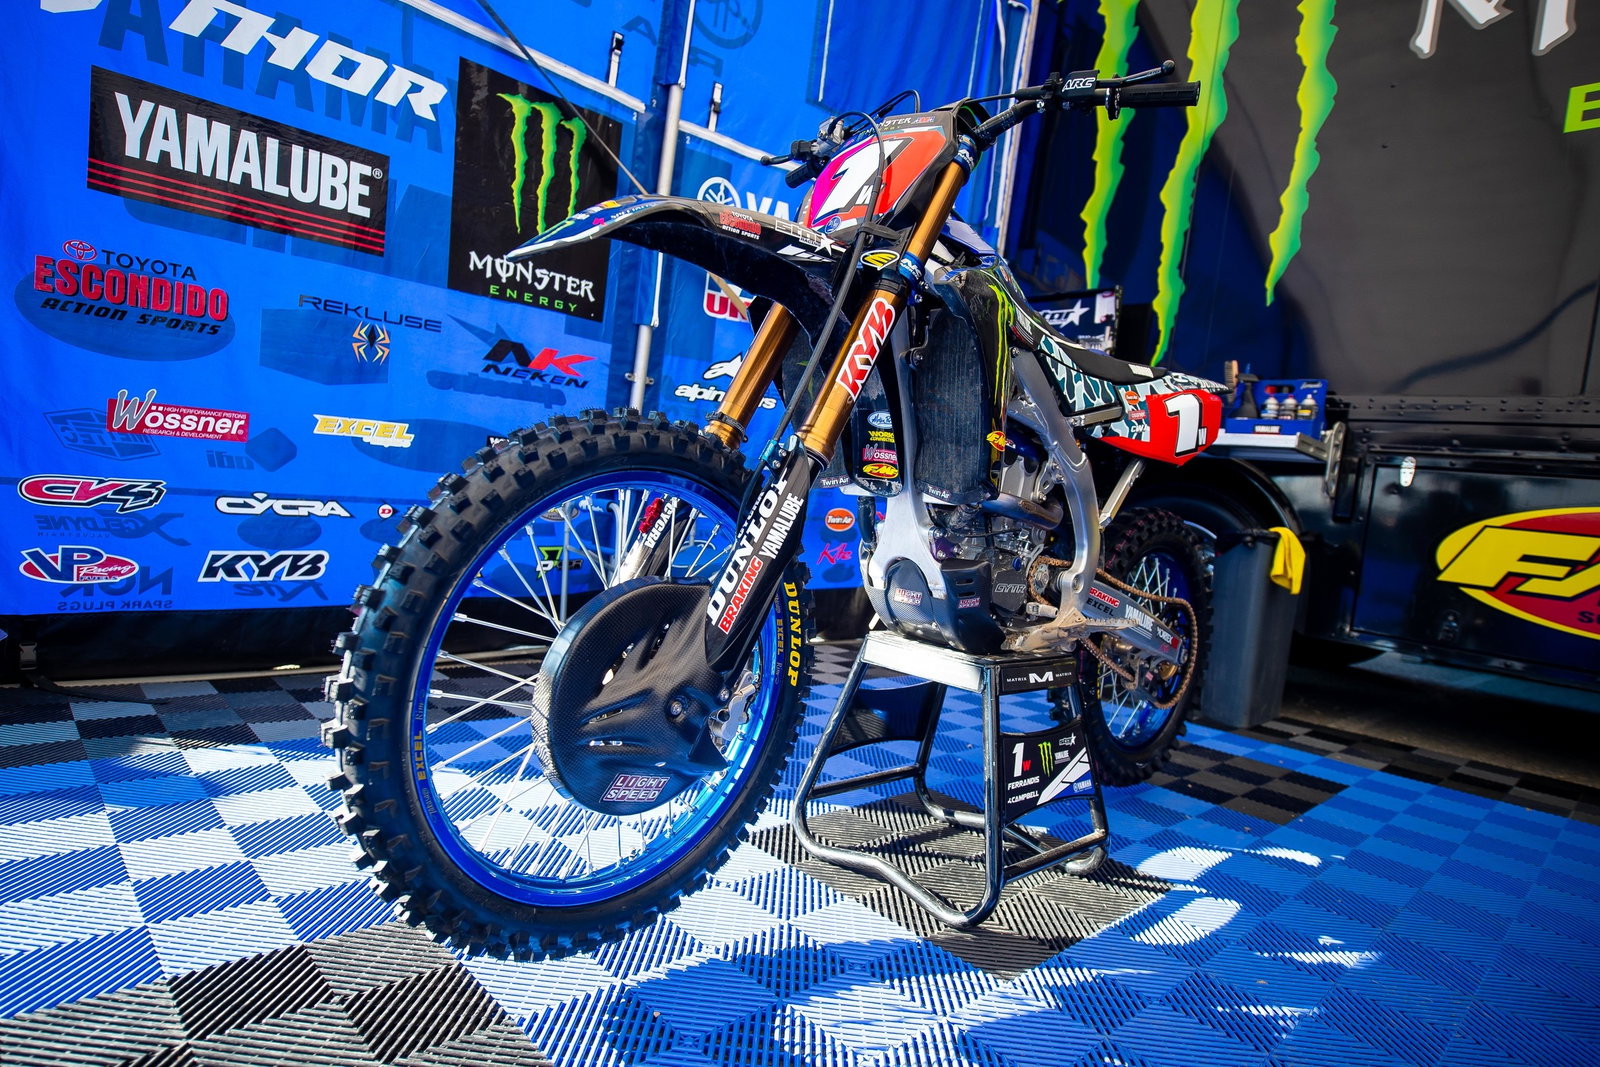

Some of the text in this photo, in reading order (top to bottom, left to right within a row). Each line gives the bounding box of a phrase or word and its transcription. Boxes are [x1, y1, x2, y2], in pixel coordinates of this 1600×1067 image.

[1062, 78, 1095, 92] ARC
[101, 250, 197, 281] TOYOTA
[468, 250, 596, 303] MONSTER
[33, 254, 229, 322] ESCONDIDO
[489, 284, 578, 313] ENERGY
[41, 297, 222, 336] ACTION SPORTS
[299, 294, 442, 333] REKLUSE
[835, 297, 896, 401] KYB
[481, 364, 589, 389] NEKEN
[142, 428, 176, 436] RESEARCH
[181, 431, 223, 440] DEVELOPMENT
[312, 413, 414, 440] EXCEL
[215, 492, 352, 517] CYCRA
[758, 492, 804, 560] YAMALUBE
[21, 545, 107, 582] VP
[79, 564, 135, 577] Racing
[198, 550, 330, 582] KYB
[717, 556, 764, 636] BRAKING
[1086, 597, 1114, 616] EXCEL
[776, 619, 784, 655] EXCEL
[783, 582, 802, 687] DUNLOP
[414, 730, 427, 781] EXCEL
[606, 789, 660, 800] SPEED
[615, 776, 669, 788] LIGHT
[1007, 776, 1040, 790] FERRANDIS
